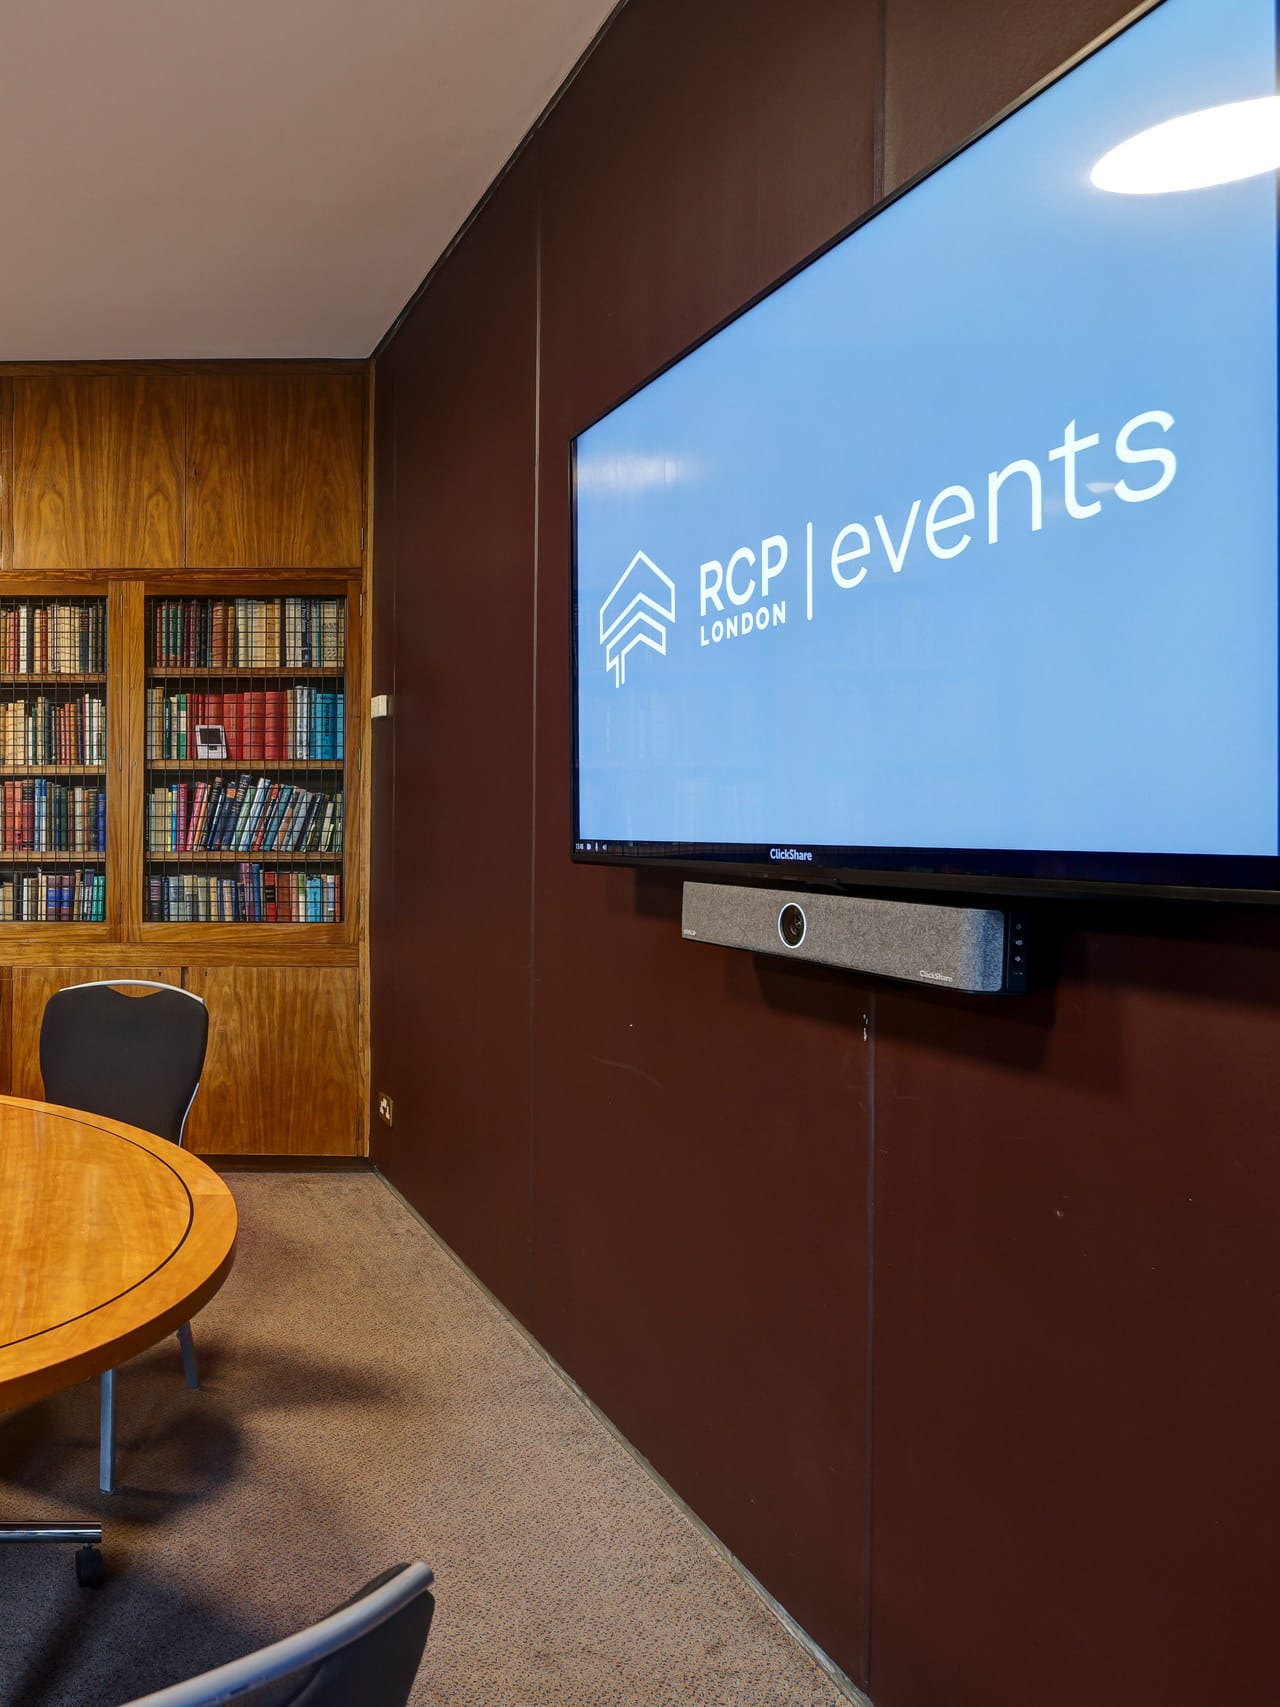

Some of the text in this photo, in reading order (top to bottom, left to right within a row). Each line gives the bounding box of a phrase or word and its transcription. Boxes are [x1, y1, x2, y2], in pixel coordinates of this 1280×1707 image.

[700, 410, 1177, 617] RCP events
[700, 600, 786, 647] LONDON
[769, 847, 813, 861] ClickShare
